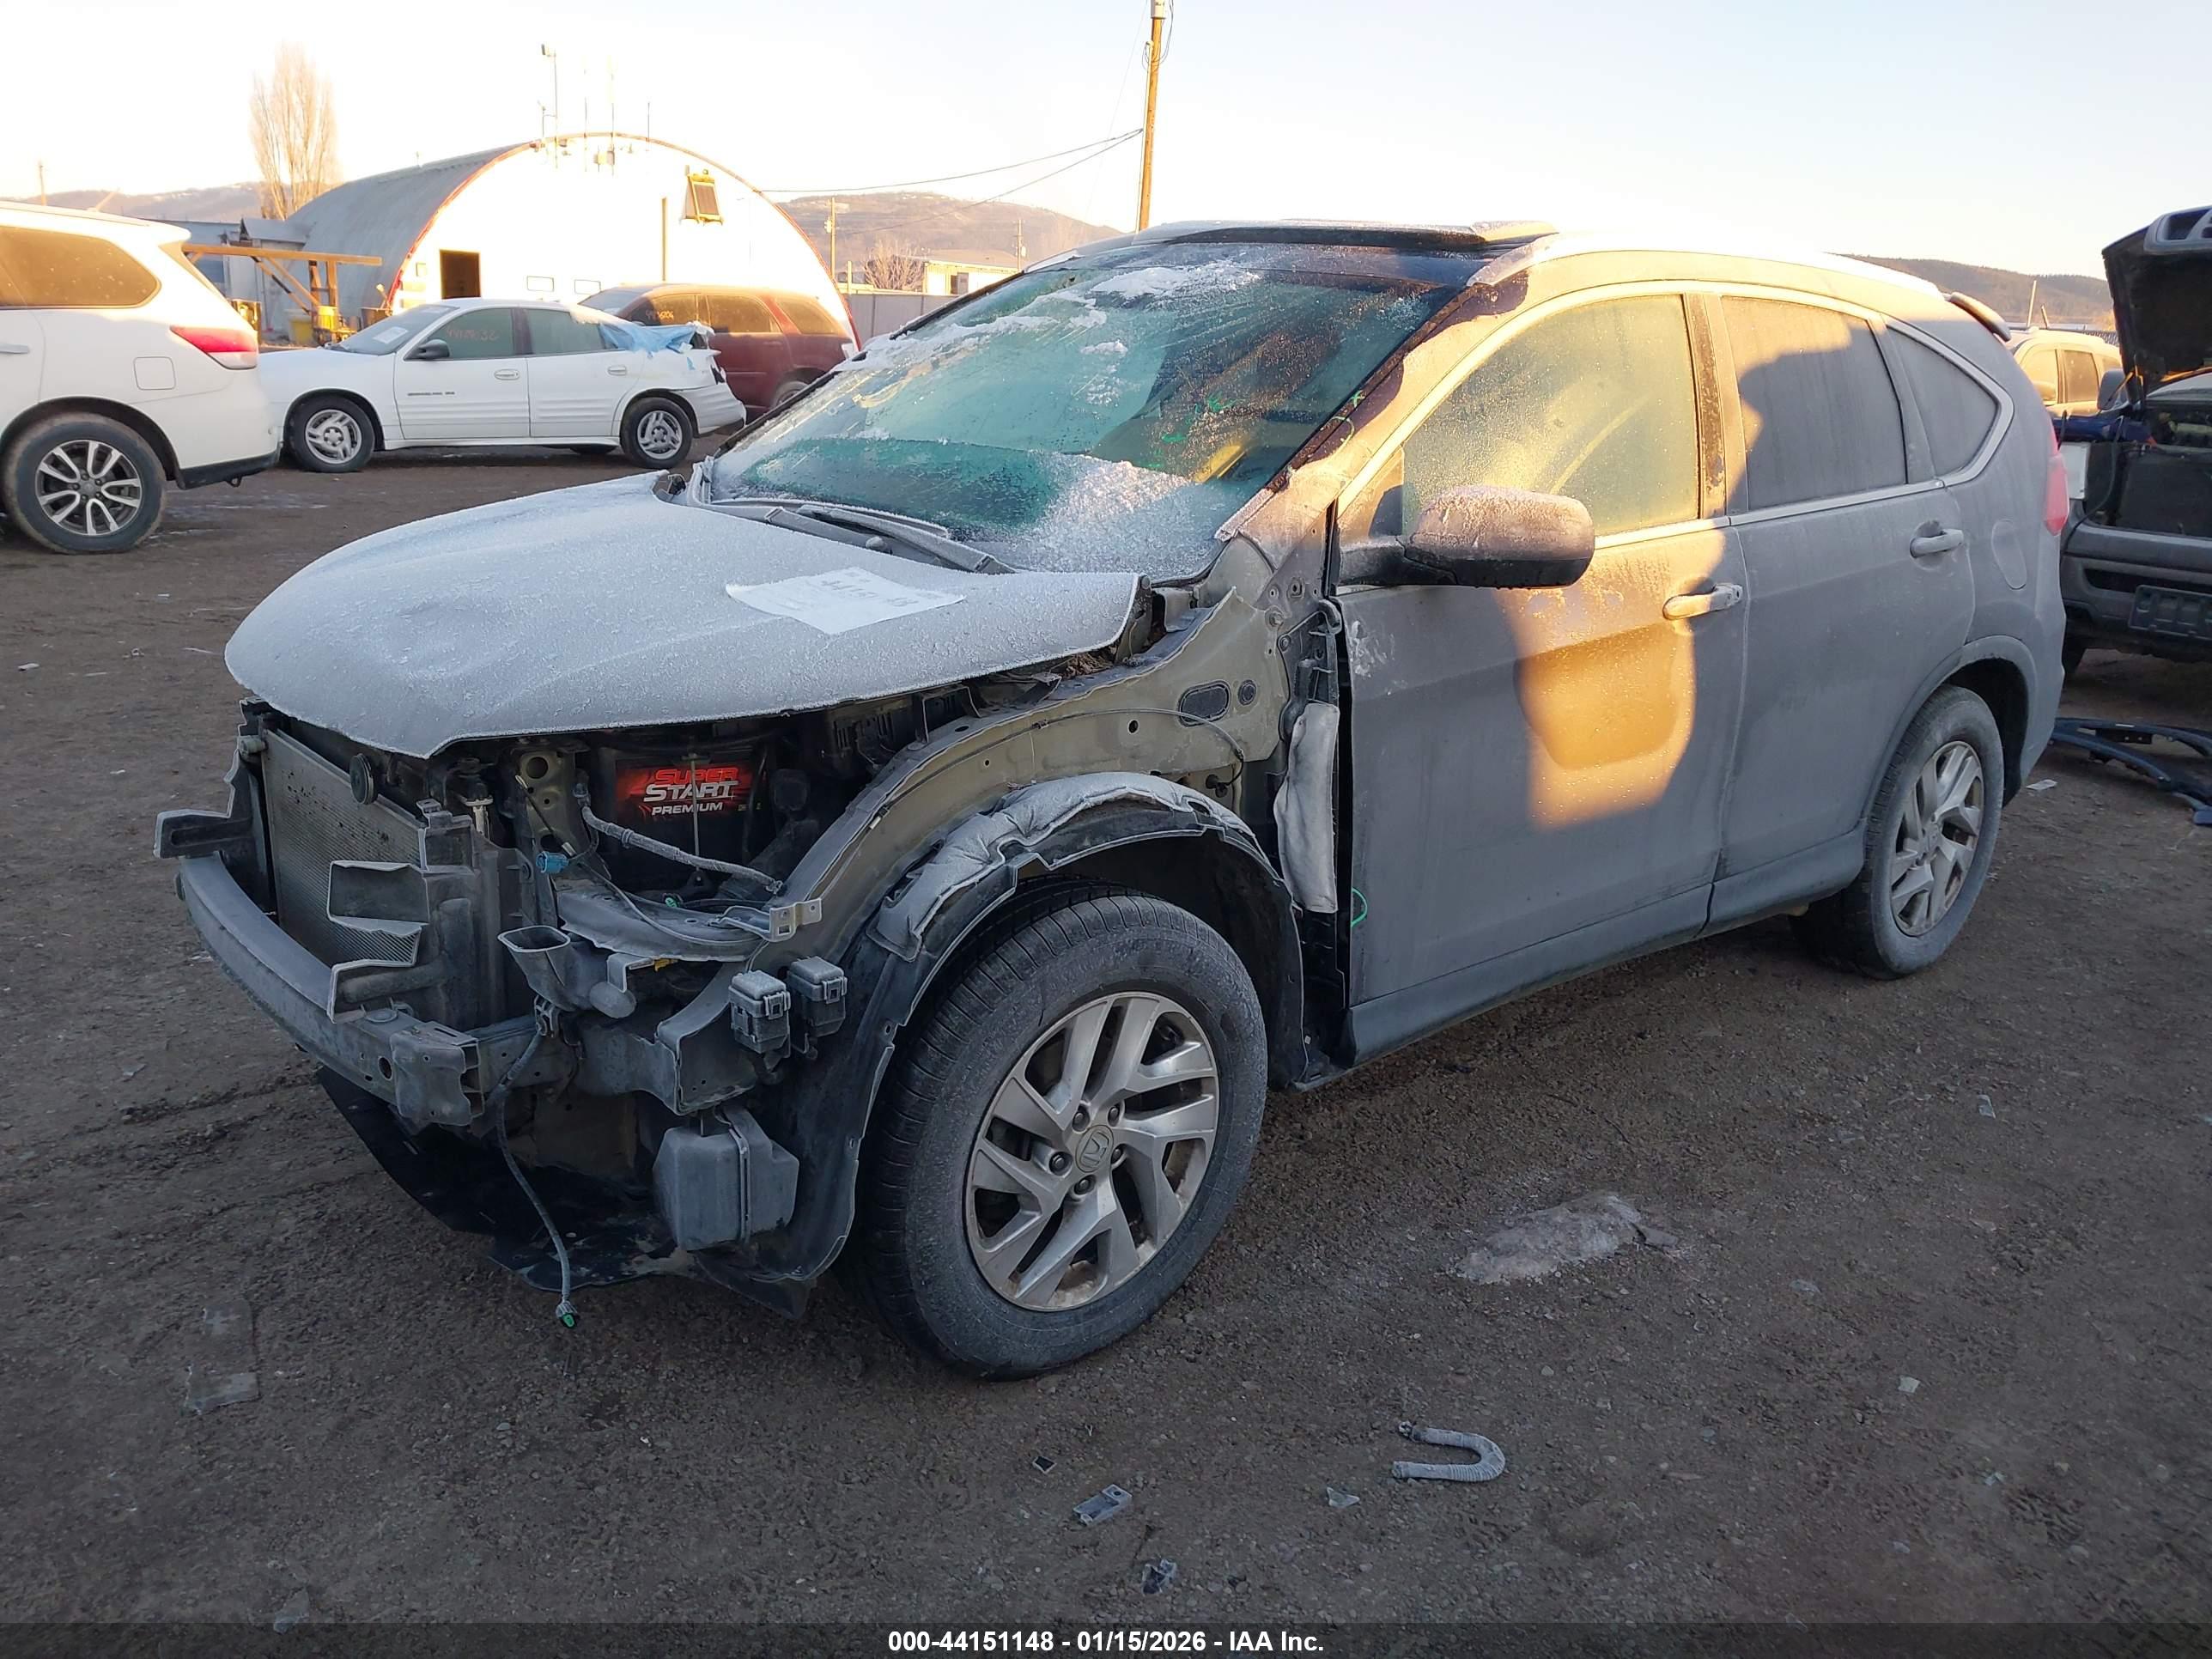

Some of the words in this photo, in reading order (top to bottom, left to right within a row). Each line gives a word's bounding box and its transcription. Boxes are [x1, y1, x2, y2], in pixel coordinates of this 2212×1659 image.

[654, 767, 738, 785] SUPER
[643, 781, 738, 802] START
[652, 802, 723, 816] PREMIUM
